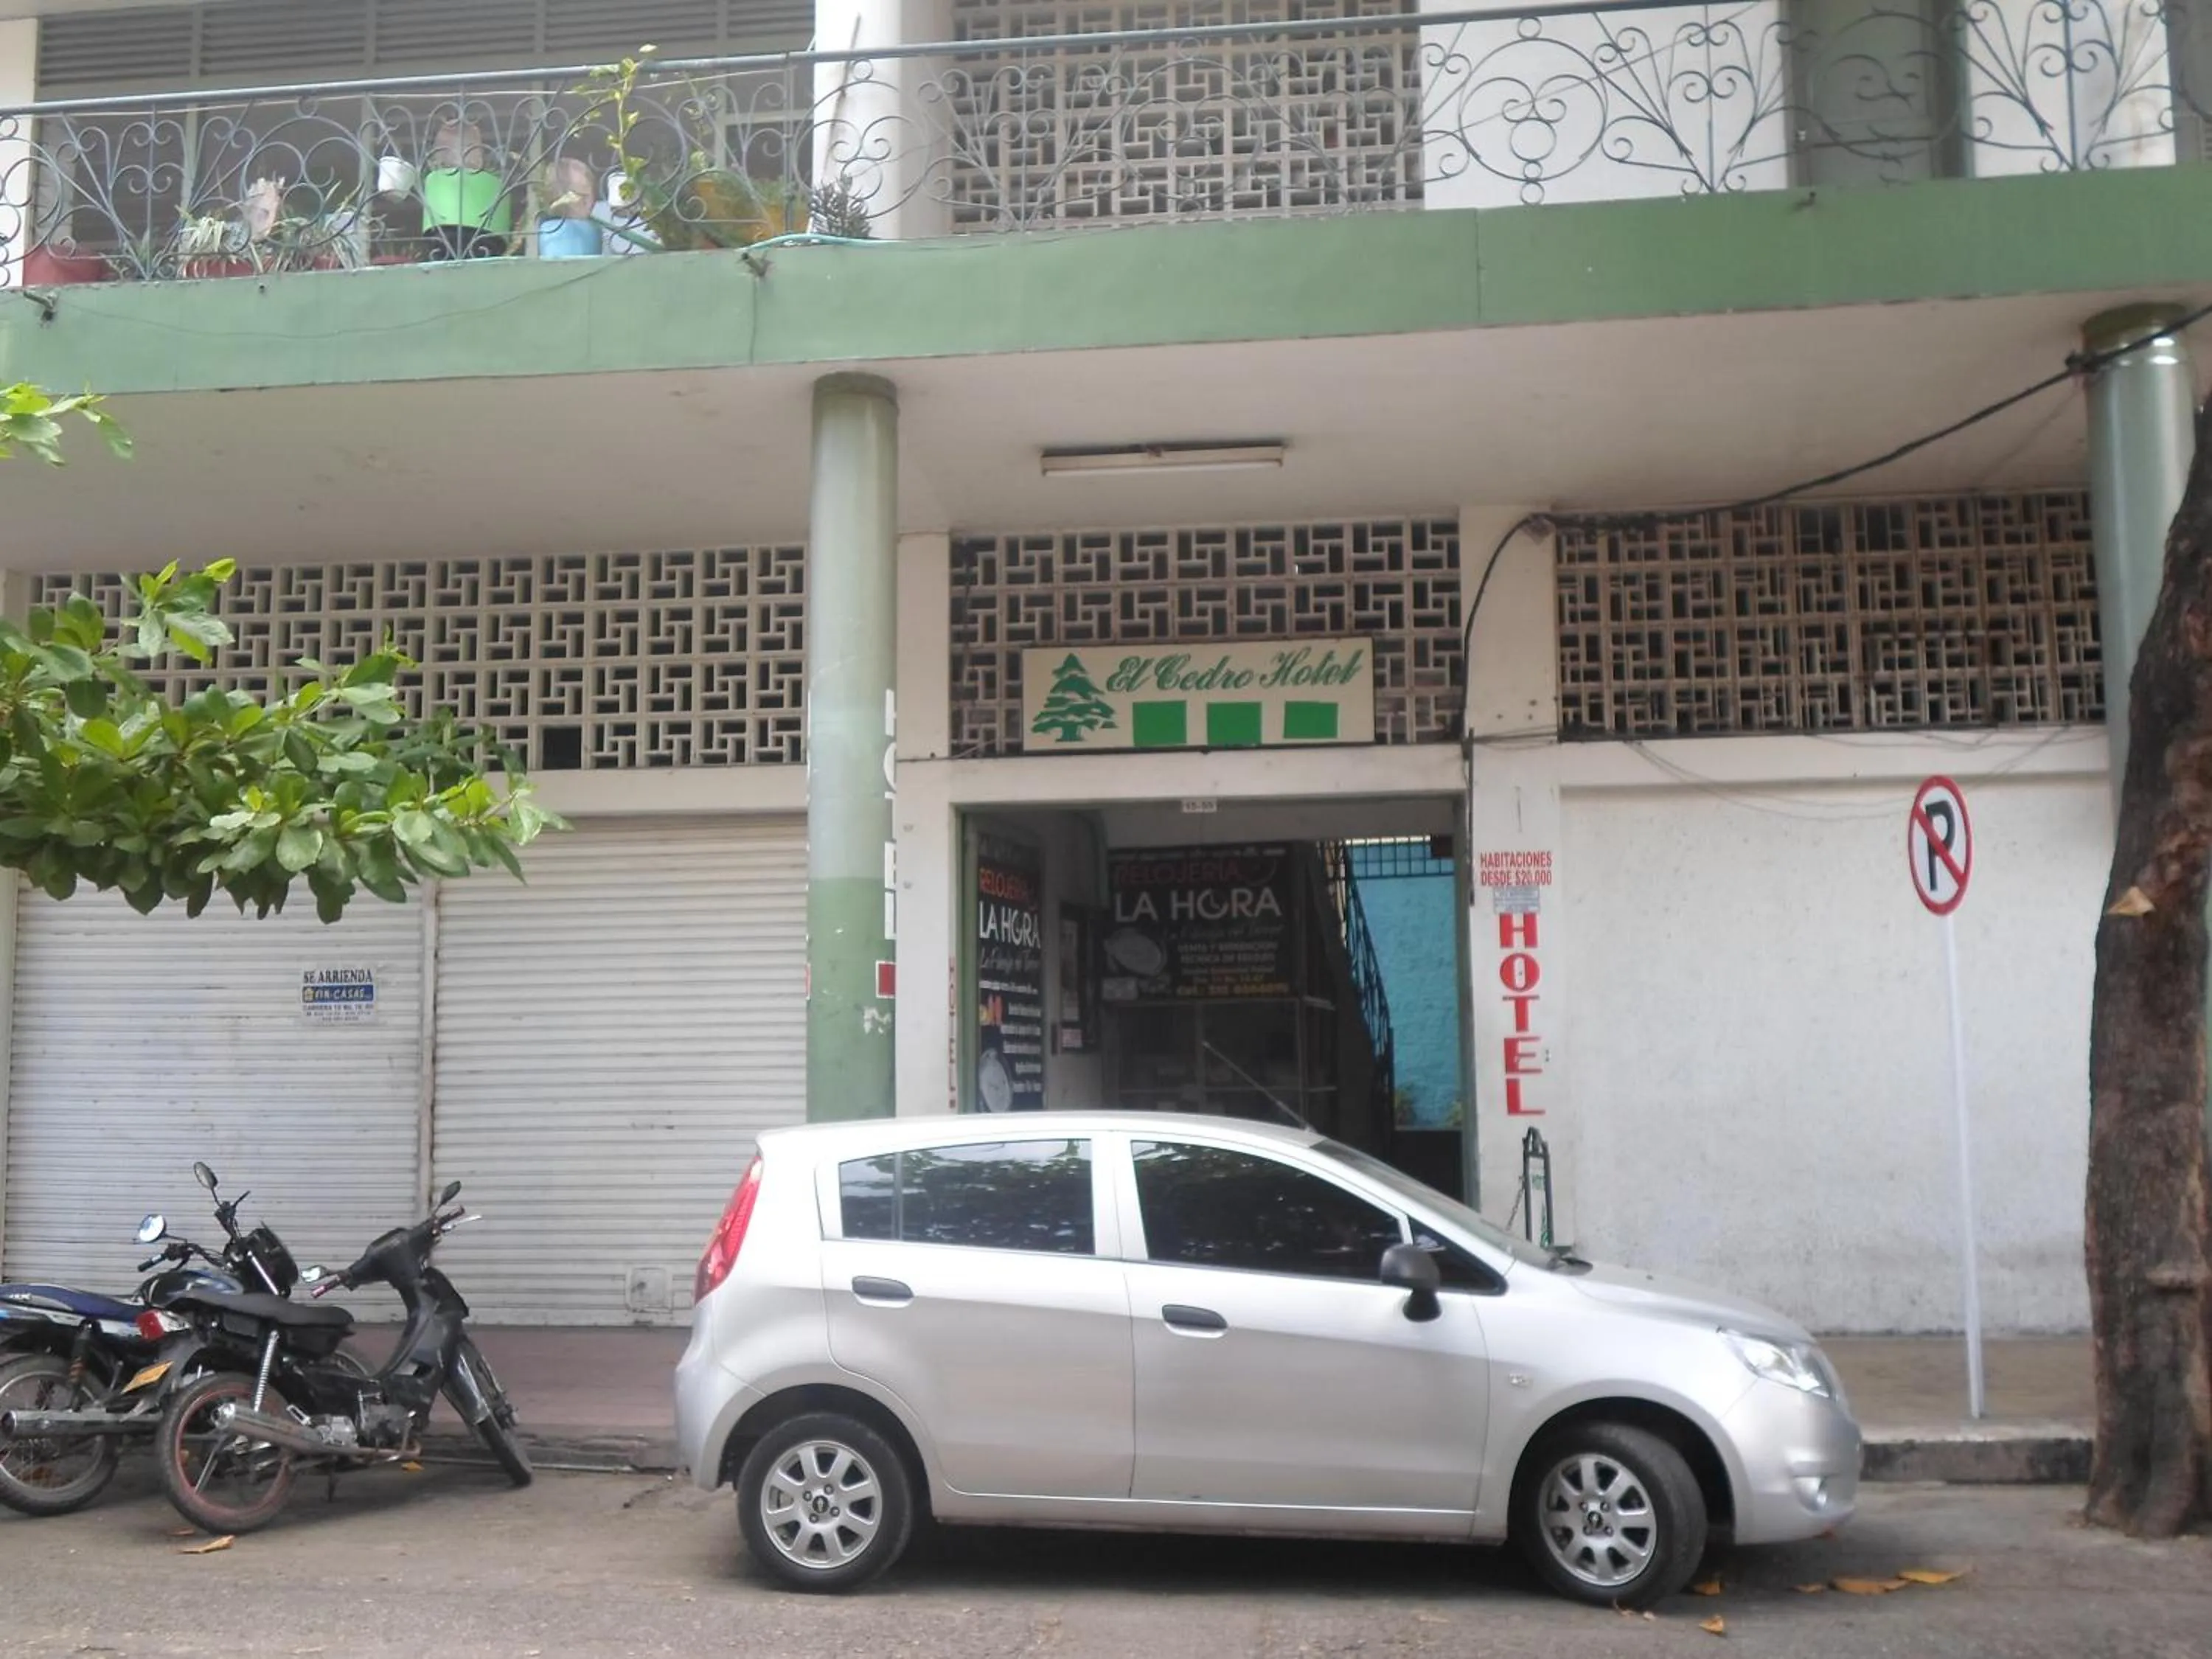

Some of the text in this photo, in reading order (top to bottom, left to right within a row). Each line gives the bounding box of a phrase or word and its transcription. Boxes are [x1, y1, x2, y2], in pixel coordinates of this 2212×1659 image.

[1106, 647, 1364, 693] El Cedro Hotel
[1480, 851, 1552, 868] HABITACIONES
[1925, 800, 1956, 891] P
[1481, 870, 1512, 886] DESDE
[1116, 886, 1283, 922] LA HORA
[979, 900, 1042, 950] LA HORA
[303, 968, 373, 984] SE ARRIENDA
[1499, 912, 1546, 1116] HOTEL
